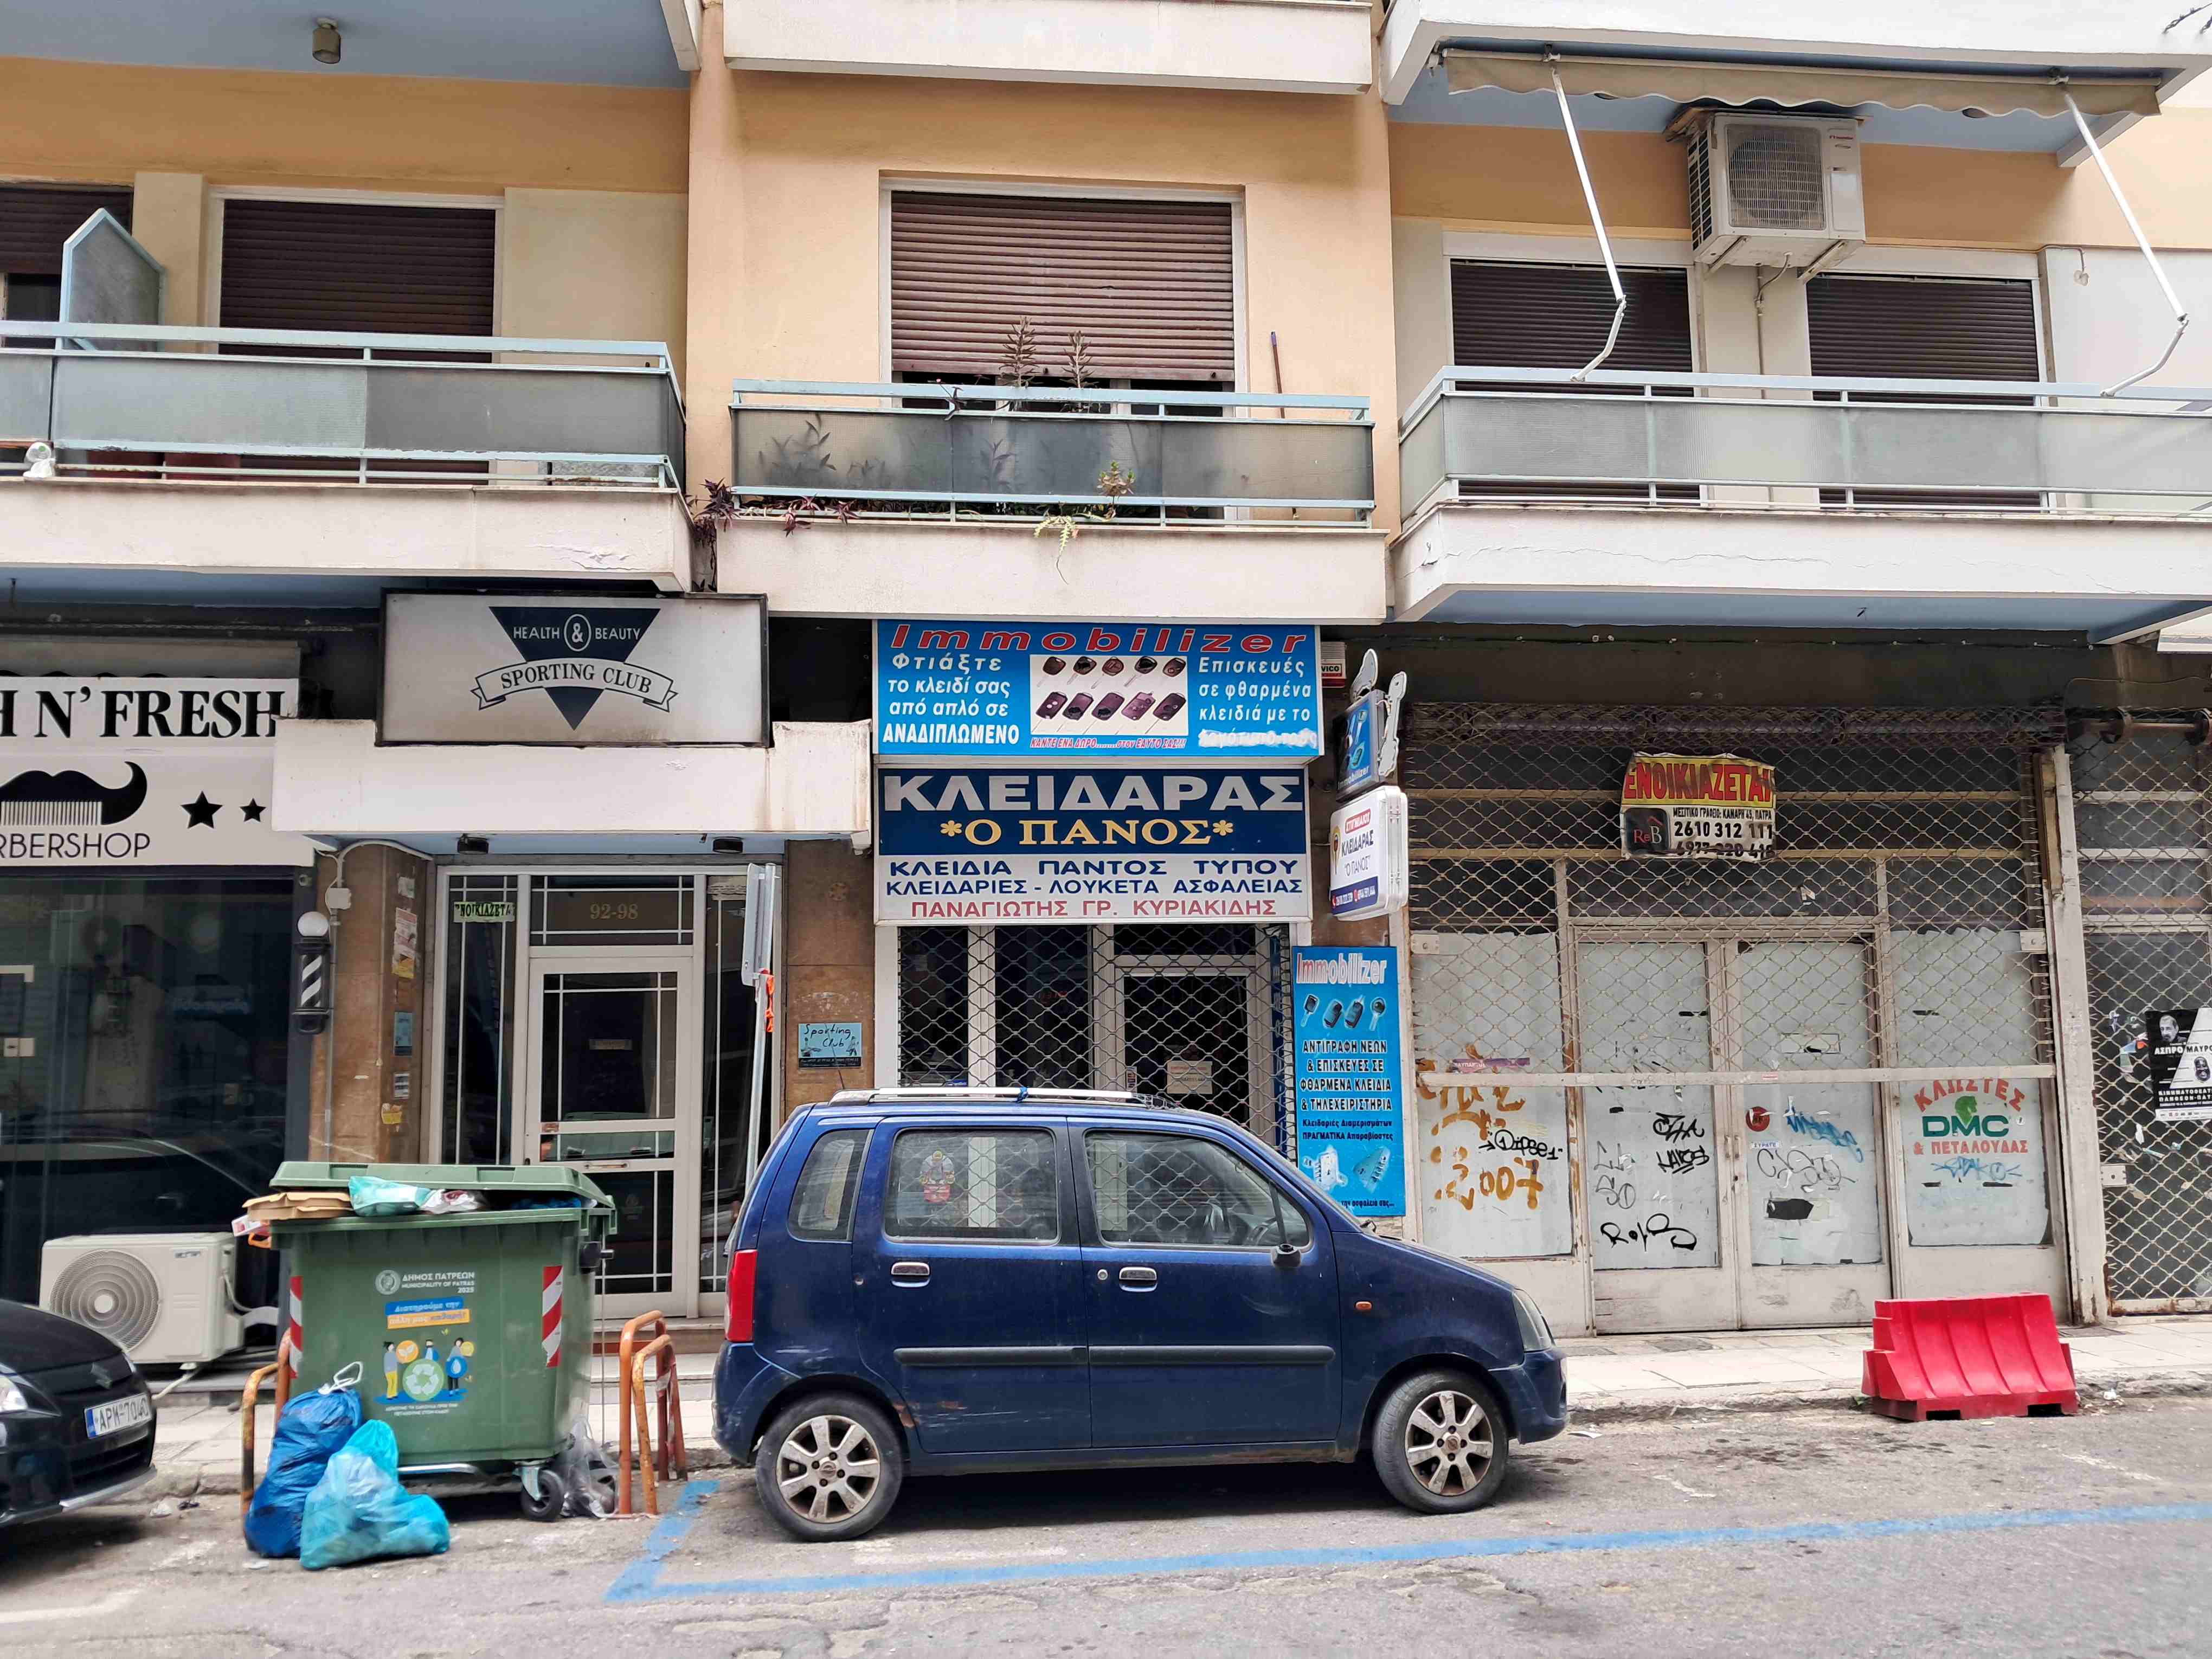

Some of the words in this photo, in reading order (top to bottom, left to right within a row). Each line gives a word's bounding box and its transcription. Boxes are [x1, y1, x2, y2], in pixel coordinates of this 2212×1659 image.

[513, 627, 561, 640] HEALTH
[571, 625, 584, 642] &
[595, 627, 642, 640] BEAUTY
[891, 624, 1306, 653] Immobilizer
[892, 652, 1002, 674] Φτιάξτε
[1199, 657, 1304, 678] Επισκευές
[501, 663, 595, 690] SPORTING
[603, 667, 652, 695] CLUB
[888, 680, 909, 693] το
[915, 676, 971, 694] κλειδί
[975, 680, 1011, 698] σας
[1199, 685, 1219, 697] σε
[1225, 680, 1311, 700] φθαρμένα
[100, 690, 286, 738] FRESH
[889, 698, 927, 715] από
[933, 698, 979, 716] απλό
[986, 703, 1008, 716] σε
[1199, 704, 1261, 721] κλειδιά
[1266, 708, 1286, 724] με
[1293, 709, 1310, 721] το
[883, 723, 1020, 744] ΑΝΑΔΙΠΛΩΜΕΝΟ
[1030, 737, 1057, 748] ΚΑΝΤΕ
[1057, 738, 1073, 748] ΕΝΑ
[1136, 738, 1162, 749] ΕΑΥΤΟ
[1624, 762, 1773, 802] ΕΝΟΙΚΙΑΖΕΤΑΙ
[884, 776, 1303, 811] ΚΛΕΙΔΑΡΑΣ
[1755, 809, 1772, 820] ΠΑΤΡΑ
[1019, 819, 1212, 846] ΠΑΝΟΣ
[1674, 821, 1710, 837] 2610
[1715, 822, 1742, 838] 312
[1748, 823, 1773, 839] 111
[1341, 829, 1374, 857] ΚΛΕΙΔΑΡΑΣ
[890, 860, 1012, 877] ΚΛΕΙΔΙΑ
[1039, 860, 1167, 876] ΠΑΝΤΟΣ
[1193, 859, 1298, 875] ΤΥΠΟΥ
[886, 879, 1027, 896] ΚΛΕΙΔΑΡΙΕΣ
[1049, 879, 1159, 895] ΛΟΥΚΕΤΑ
[1173, 879, 1302, 894] ΑΣΦΑΛΕΙΑΣ
[590, 903, 638, 919] 92-98
[911, 901, 1068, 918] ΠΑΝΑΓΙΩΤΗΣ
[1083, 899, 1117, 917] ΓΡ.
[1133, 899, 1276, 916] ΚΥΡΙΑΚΙΔΗΣ
[1296, 953, 1387, 985] Immobilizer
[804, 1024, 851, 1040] Sporting
[822, 1038, 844, 1047] Club
[1303, 1040, 1357, 1053] ΑΝΤΙΓΡΑΦΗ
[1360, 1040, 1387, 1053] ΝΕΩΝ
[2155, 1046, 2184, 1055] ΑΣΠΡΟ
[1307, 1059, 1315, 1072] &
[1317, 1059, 1369, 1072] ΕΠΙΣΚΕΥΕΣ
[1373, 1059, 1384, 1072] ΣΕ
[1300, 1078, 1352, 1091] ΦΘΑΡΜΕΝΑ
[1355, 1078, 1392, 1091] ΚΛΕΙΔΙΑ
[1914, 1078, 2025, 1112] ΚΛΩΣΤΕΣ
[1301, 1099, 1307, 1111] &
[1310, 1098, 1392, 1111] ΤΗΛΕΧΕΙΡΙΣΤΗΡΙΑ
[1303, 1119, 1339, 1128] Κλειδαριές
[1341, 1119, 1392, 1128] Διαμερισμάτων
[1922, 1115, 2009, 1137] DMC
[1347, 1131, 1393, 1141] Απαραβίαστες
[1931, 1140, 2028, 1155] ΠΕΤΑΛΟΥΔΑΣ
[402, 1274, 433, 1282] ΔΗΜΟΣ
[435, 1272, 474, 1280] ΠΑΤΡΕΩΝ
